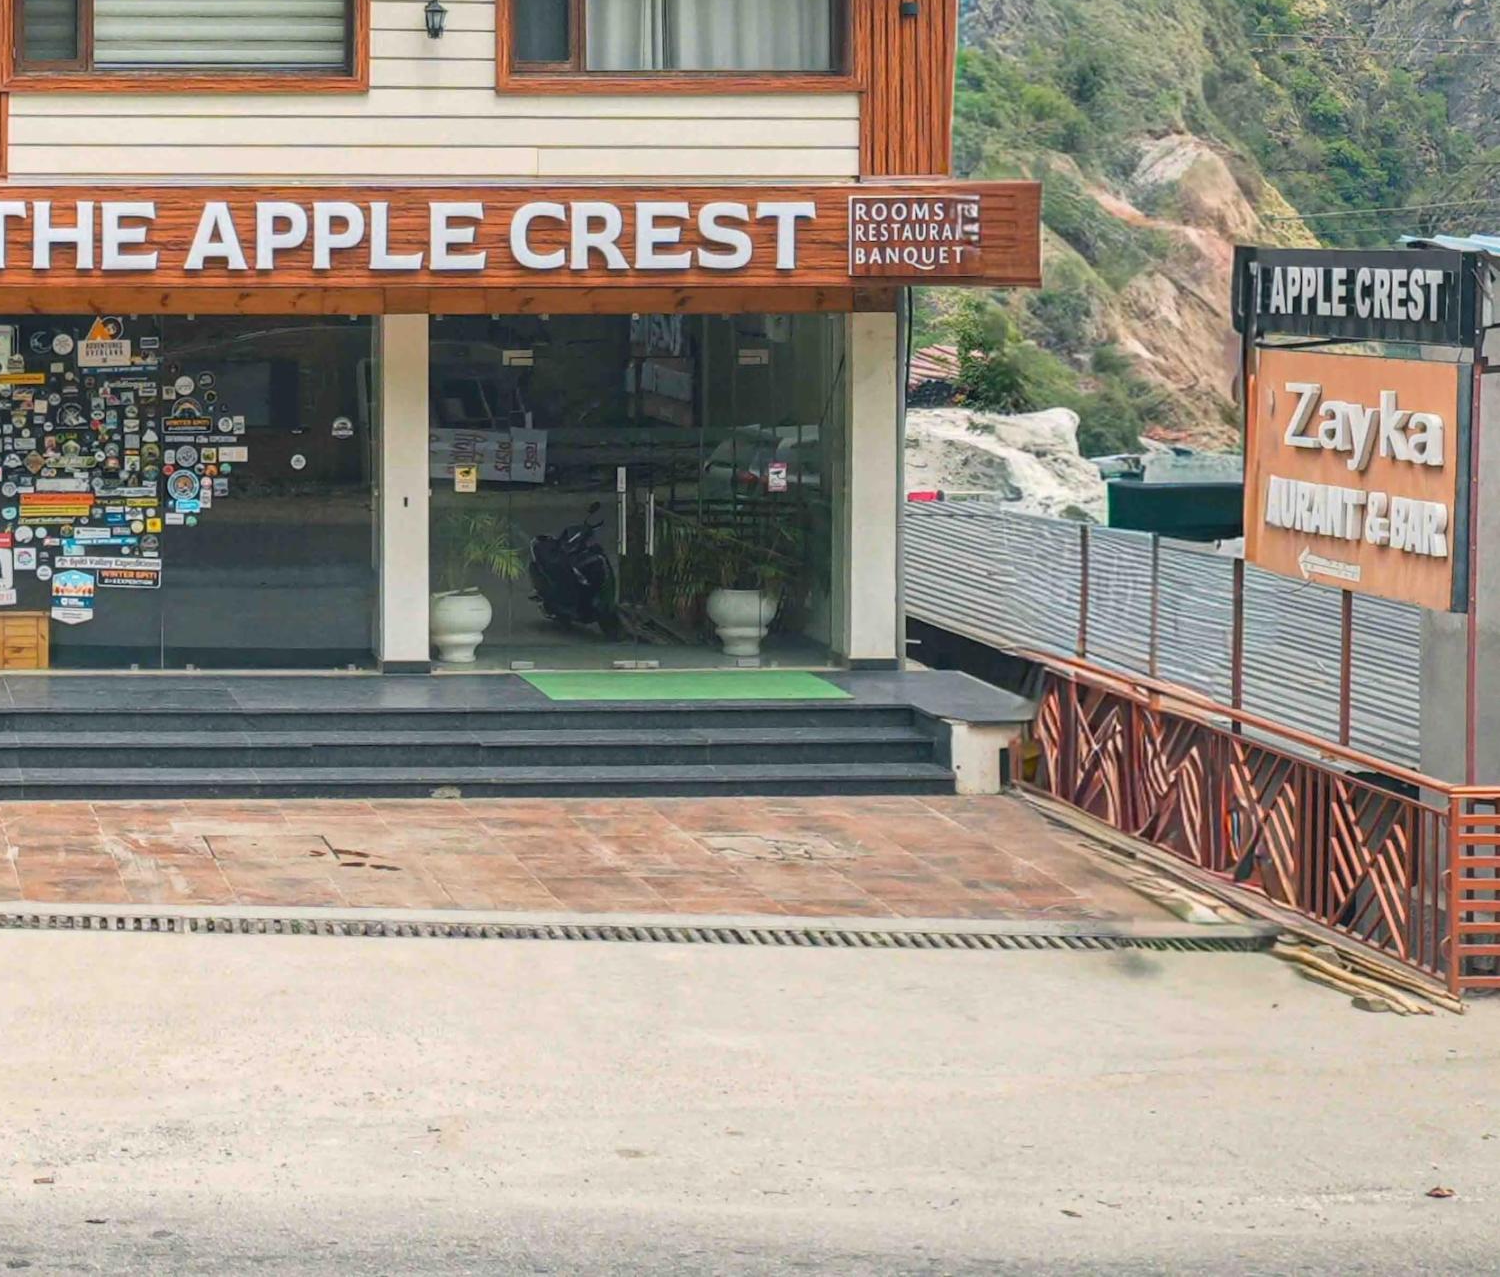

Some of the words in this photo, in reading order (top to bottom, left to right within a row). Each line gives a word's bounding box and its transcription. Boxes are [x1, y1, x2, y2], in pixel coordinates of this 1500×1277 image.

[183, 201, 487, 270] APPLE
[510, 201, 817, 270] CREST
[855, 203, 945, 221] ROOMS
[855, 247, 964, 270] BANQUET
[1269, 266, 1347, 317] APPLE
[1354, 267, 1444, 322] CREST
[1284, 382, 1445, 471] Zayka
[1365, 491, 1390, 545] &
[1390, 496, 1448, 557] BAR
